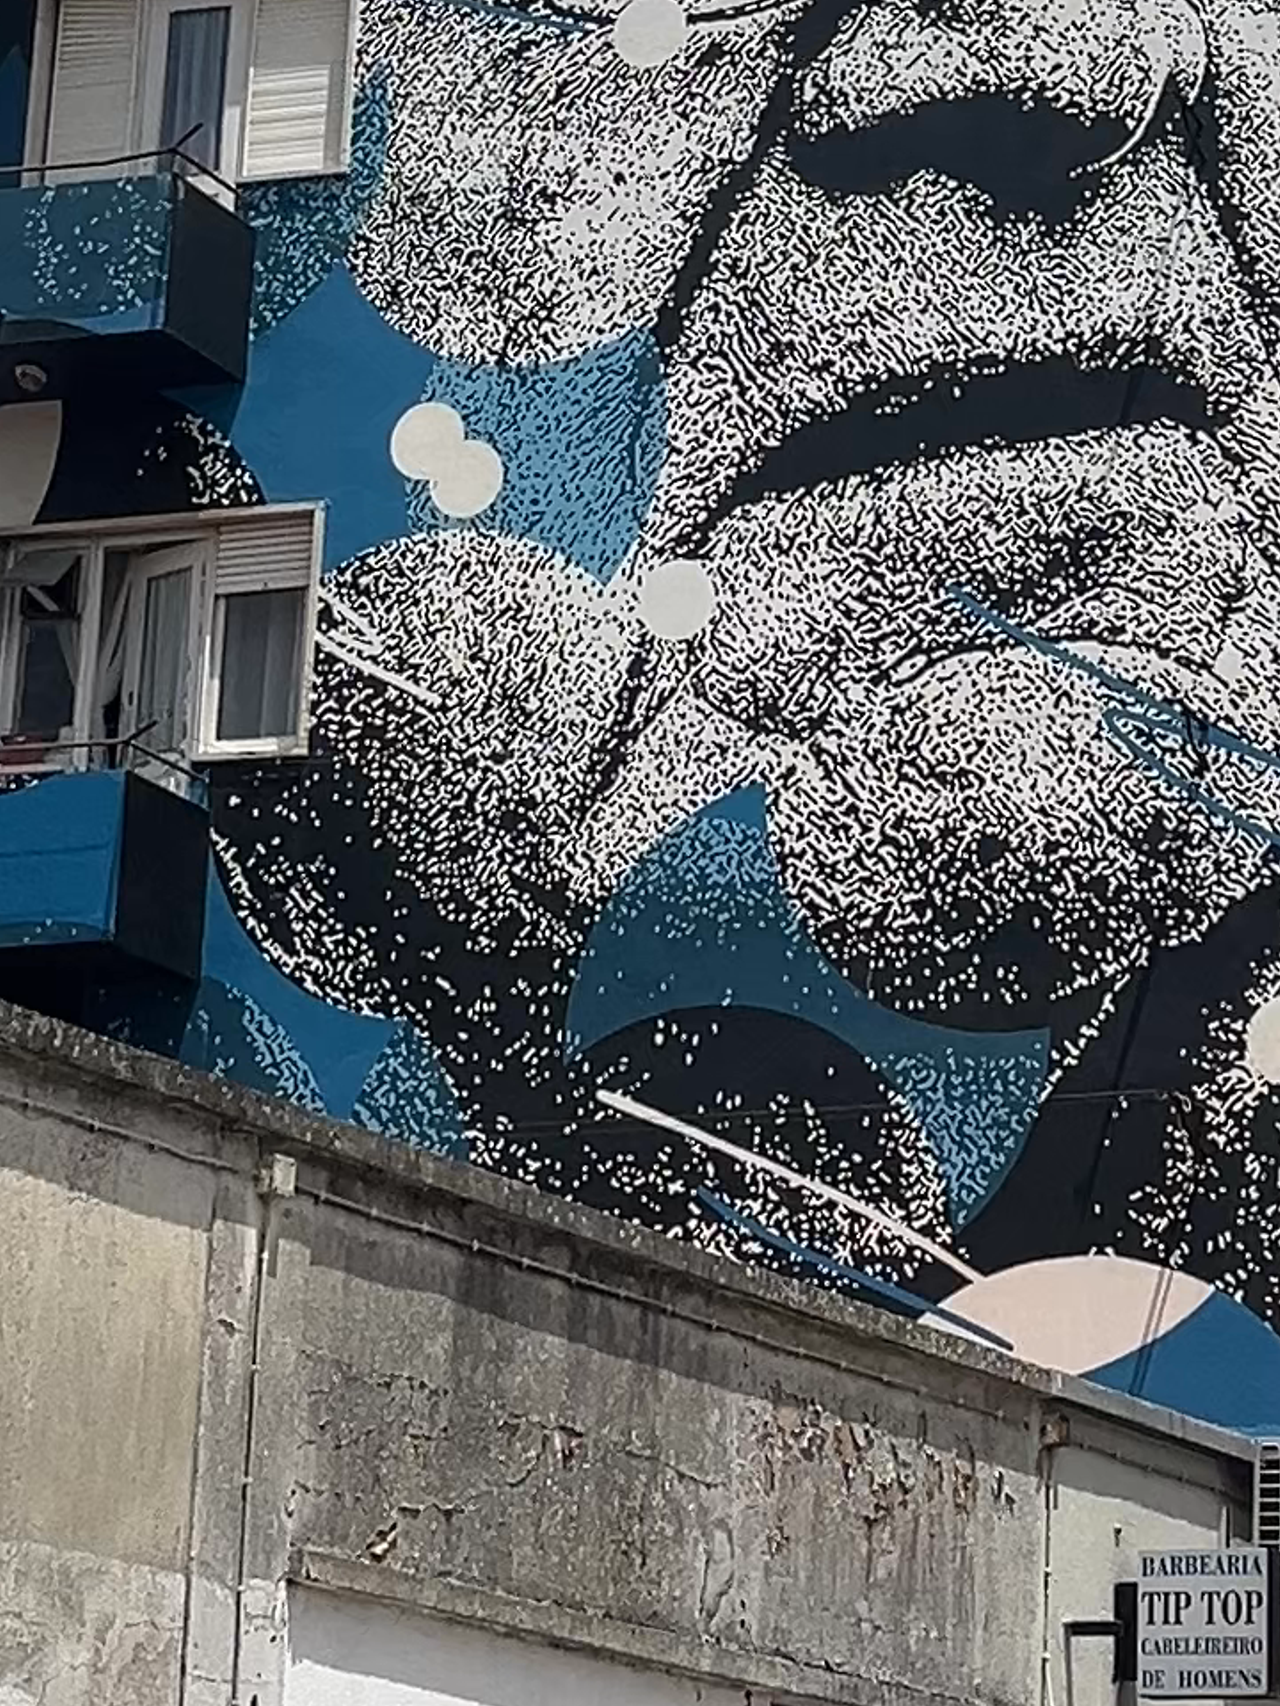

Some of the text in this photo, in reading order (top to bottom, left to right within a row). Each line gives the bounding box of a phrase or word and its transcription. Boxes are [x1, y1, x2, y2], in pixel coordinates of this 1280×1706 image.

[1141, 1553, 1264, 1578] BARBEARIA
[1140, 1589, 1264, 1626] TIP TOP
[1140, 1636, 1264, 1656] CABELEIREIRO
[1142, 1669, 1263, 1689] DE HOMENS
